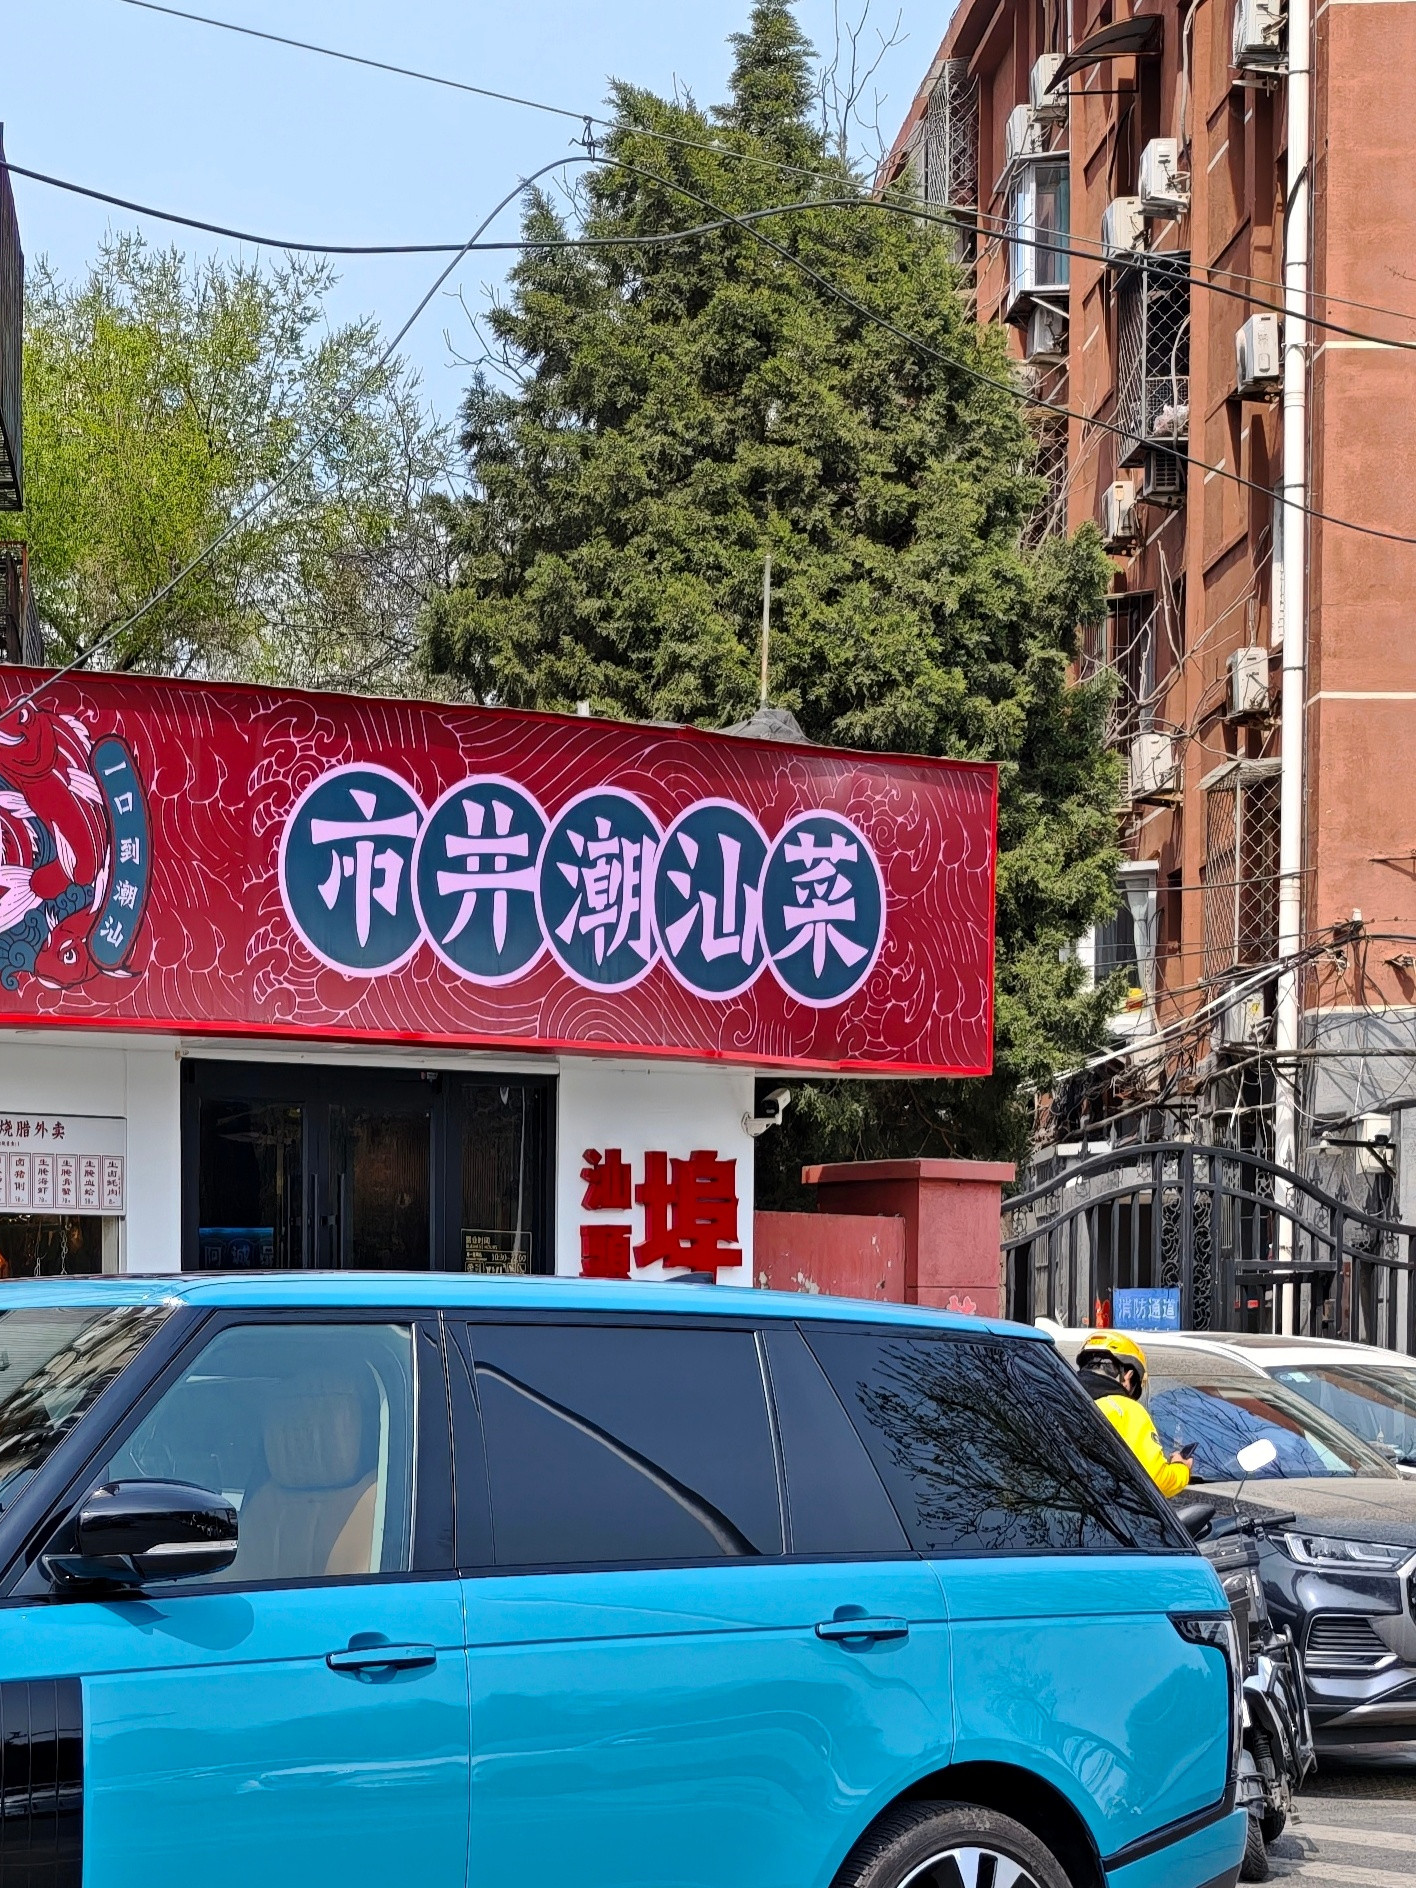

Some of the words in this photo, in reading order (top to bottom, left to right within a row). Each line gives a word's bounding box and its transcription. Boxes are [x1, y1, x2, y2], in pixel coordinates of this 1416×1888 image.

[99, 760, 141, 949] 一口到潮汕
[309, 787, 869, 980] 市井潮汕菜
[37, 1158, 50, 1195] 生腌海虾
[60, 1159, 73, 1196] 生腌膏蟹
[1118, 1297, 1177, 1320] 消防通道
